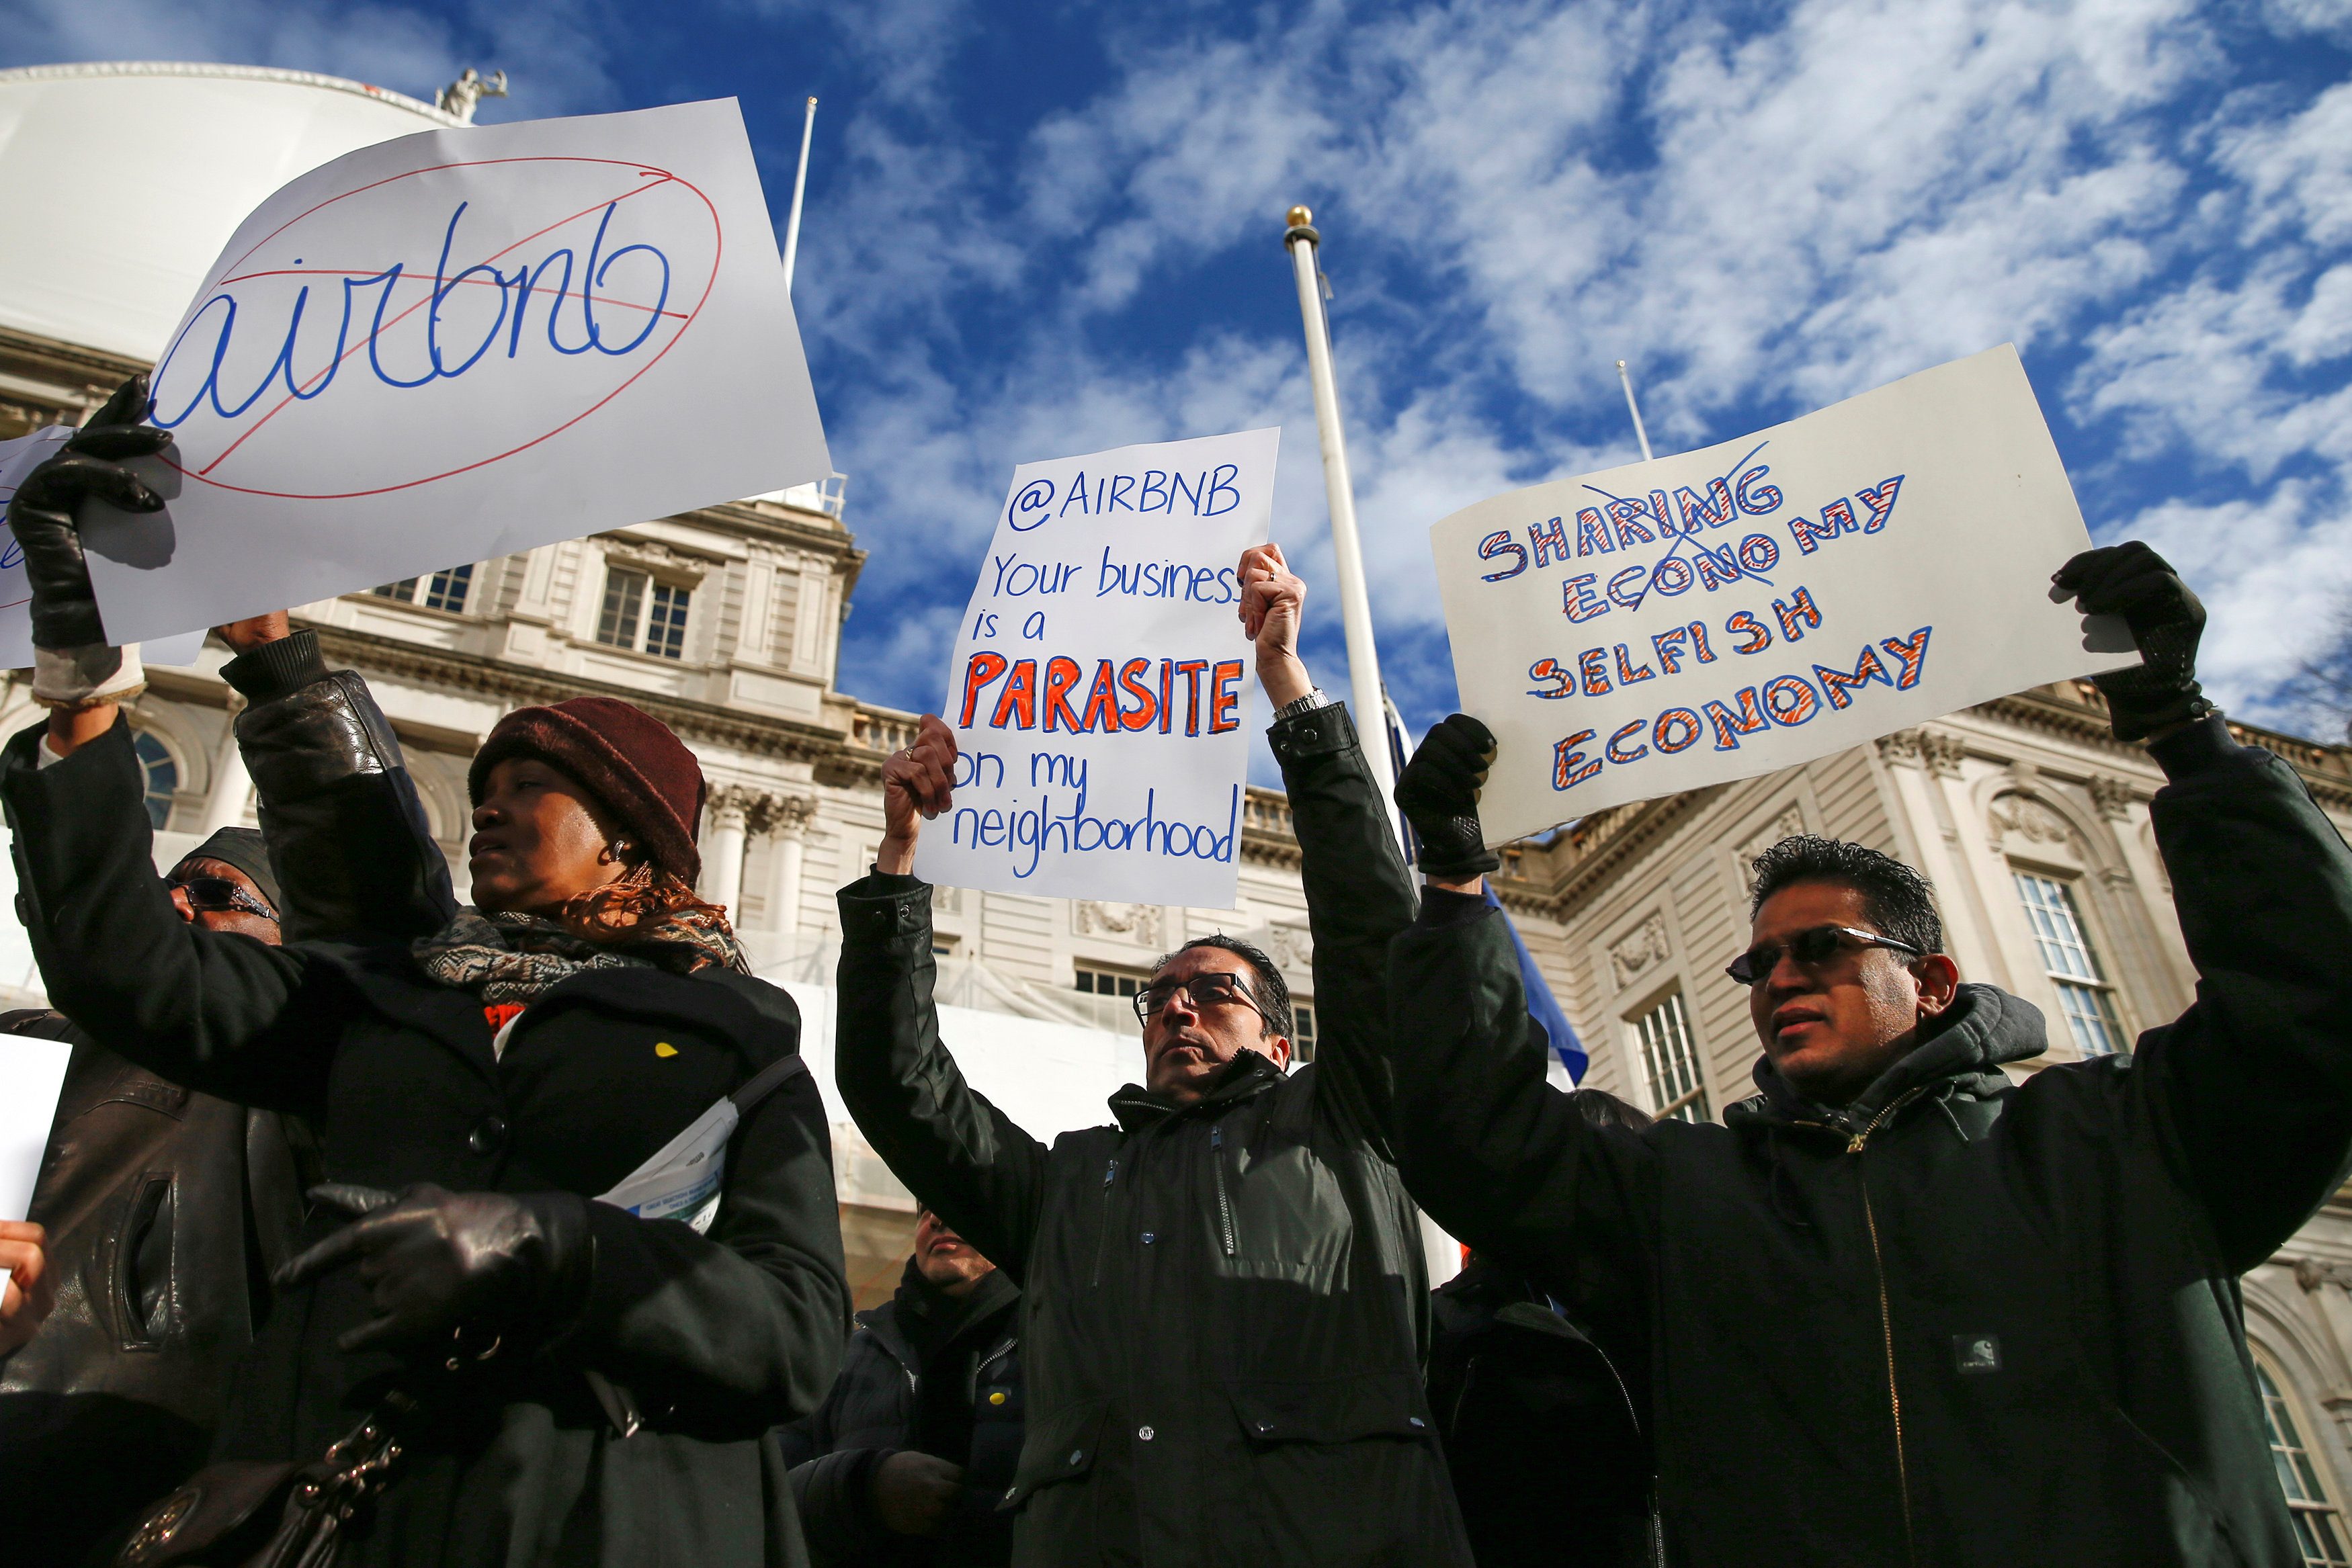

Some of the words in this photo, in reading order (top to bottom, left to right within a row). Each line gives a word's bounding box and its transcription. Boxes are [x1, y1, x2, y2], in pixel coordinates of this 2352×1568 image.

[148, 202, 670, 429] airbnb
[1008, 464, 1241, 531] @AIRBNB
[1477, 464, 1784, 582] SHARING
[991, 553, 1083, 598] Your
[1096, 546, 1242, 604] busines
[972, 608, 999, 641] is
[1022, 611, 1046, 641] a
[1526, 585, 1823, 700] SELFISH
[958, 650, 1245, 738] PARASITE
[1552, 625, 1933, 792] ECONOMY
[953, 783, 1238, 879] neighborhood
[1031, 752, 1087, 821] my
